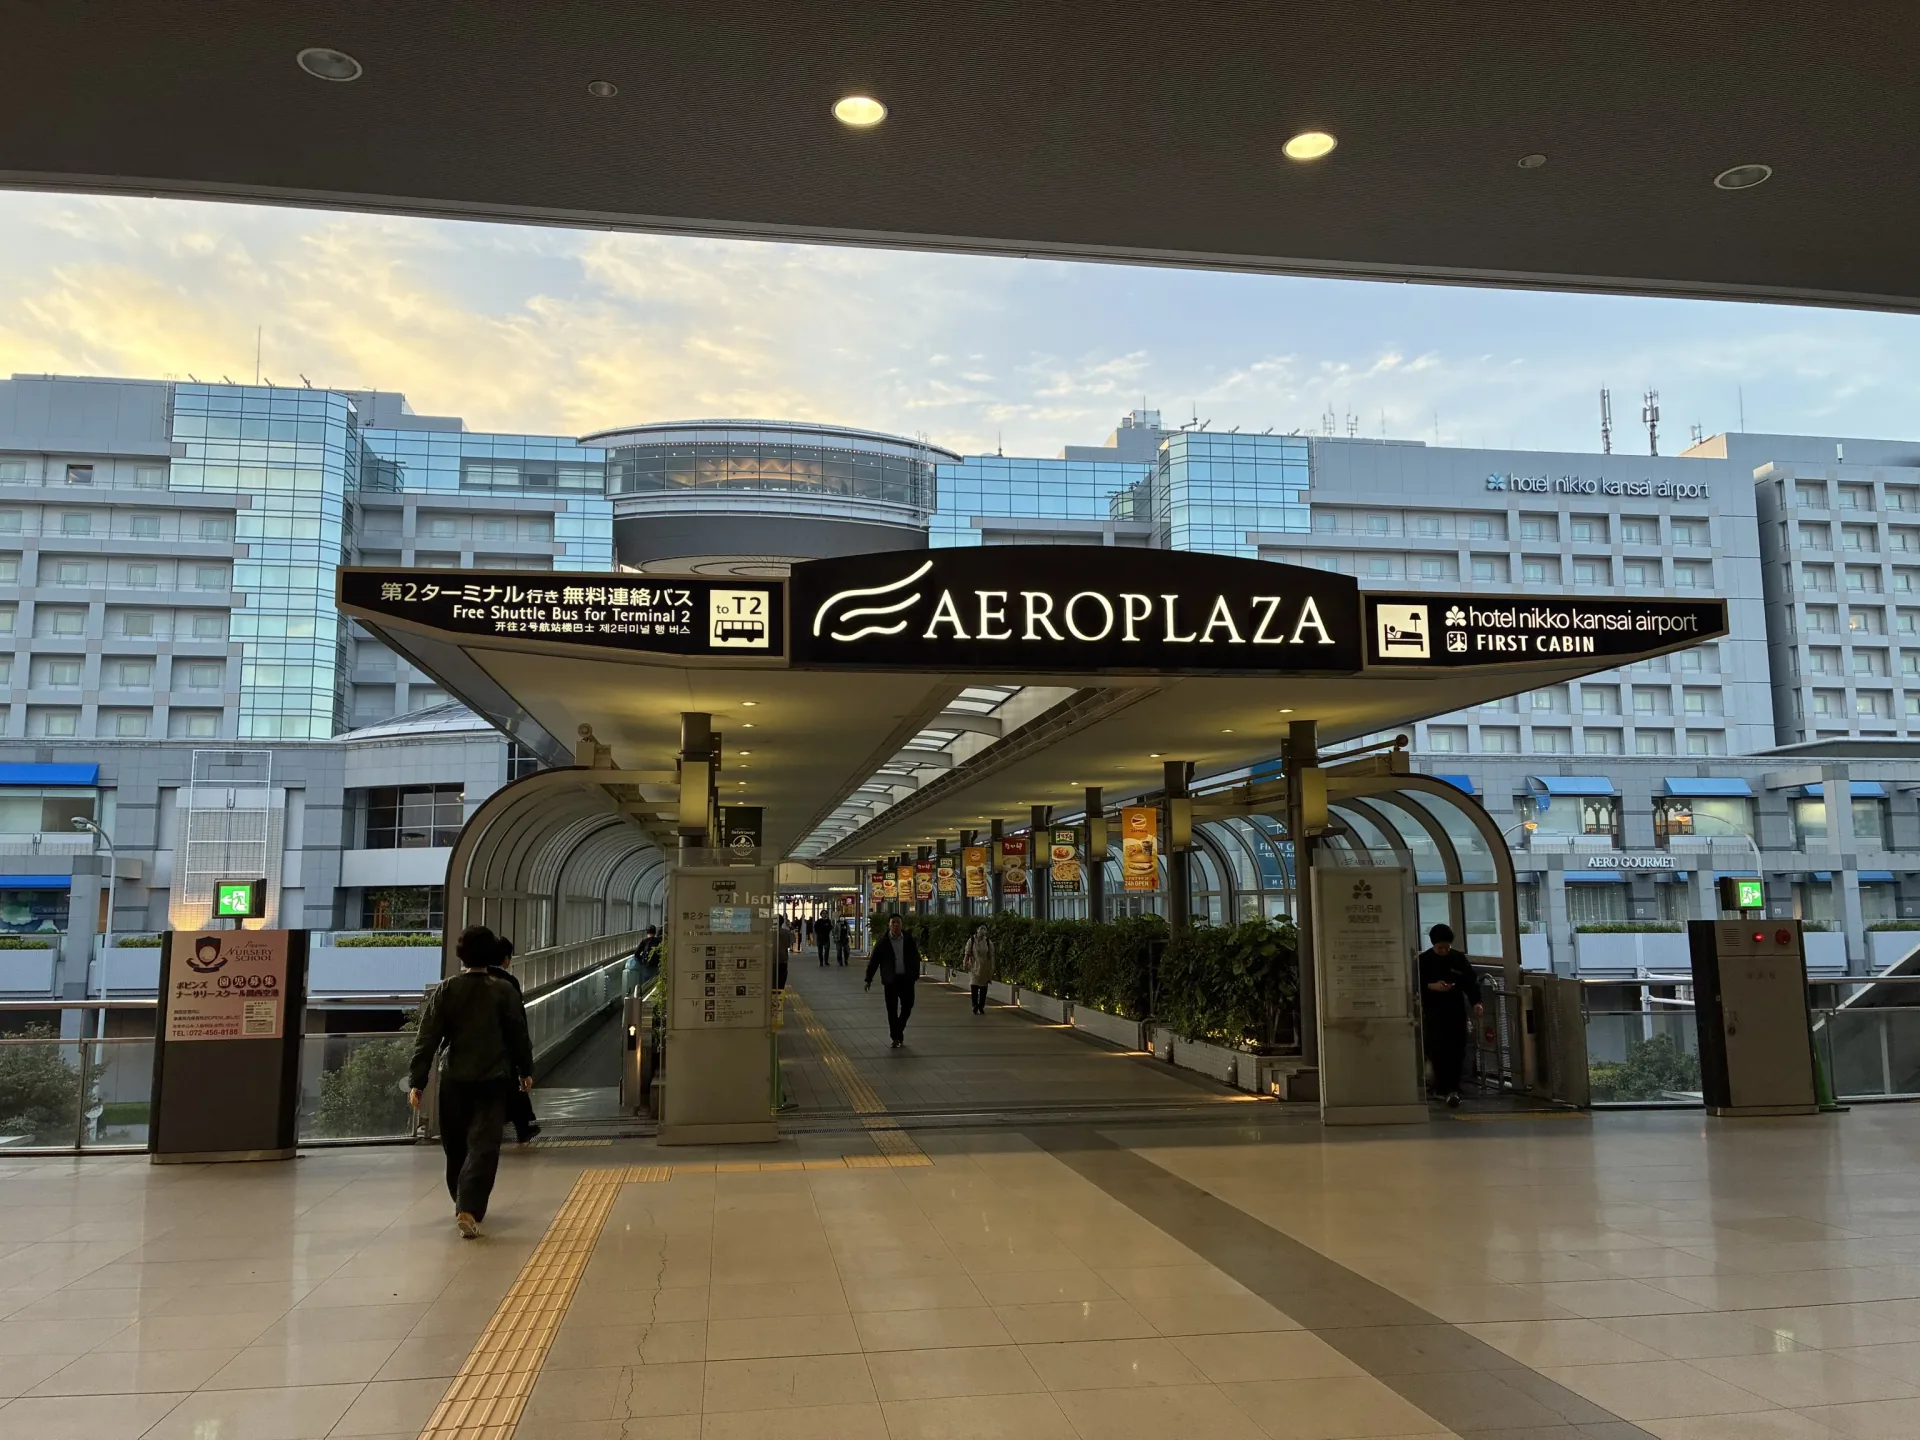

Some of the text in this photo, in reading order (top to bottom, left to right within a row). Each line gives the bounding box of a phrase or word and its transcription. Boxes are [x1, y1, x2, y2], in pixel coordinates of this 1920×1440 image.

[1509, 472, 1710, 501] hotel nikko kansai airport
[453, 605, 690, 623] Free Shuttle Bus for Terminal 2
[716, 604, 730, 615] to
[923, 589, 1336, 645] AEROPLAZA
[1470, 606, 1698, 636] hotel nikko kansai airport
[495, 621, 595, 633] 开往2号航站楼巴士
[599, 623, 690, 635] 제2터미널 행 버스
[1477, 634, 1595, 653] FIRST CABIN
[1260, 842, 1284, 851] FIT
[1588, 856, 1676, 868] AERO GOURMET
[717, 894, 731, 904] T2
[226, 946, 274, 956] NURSERY
